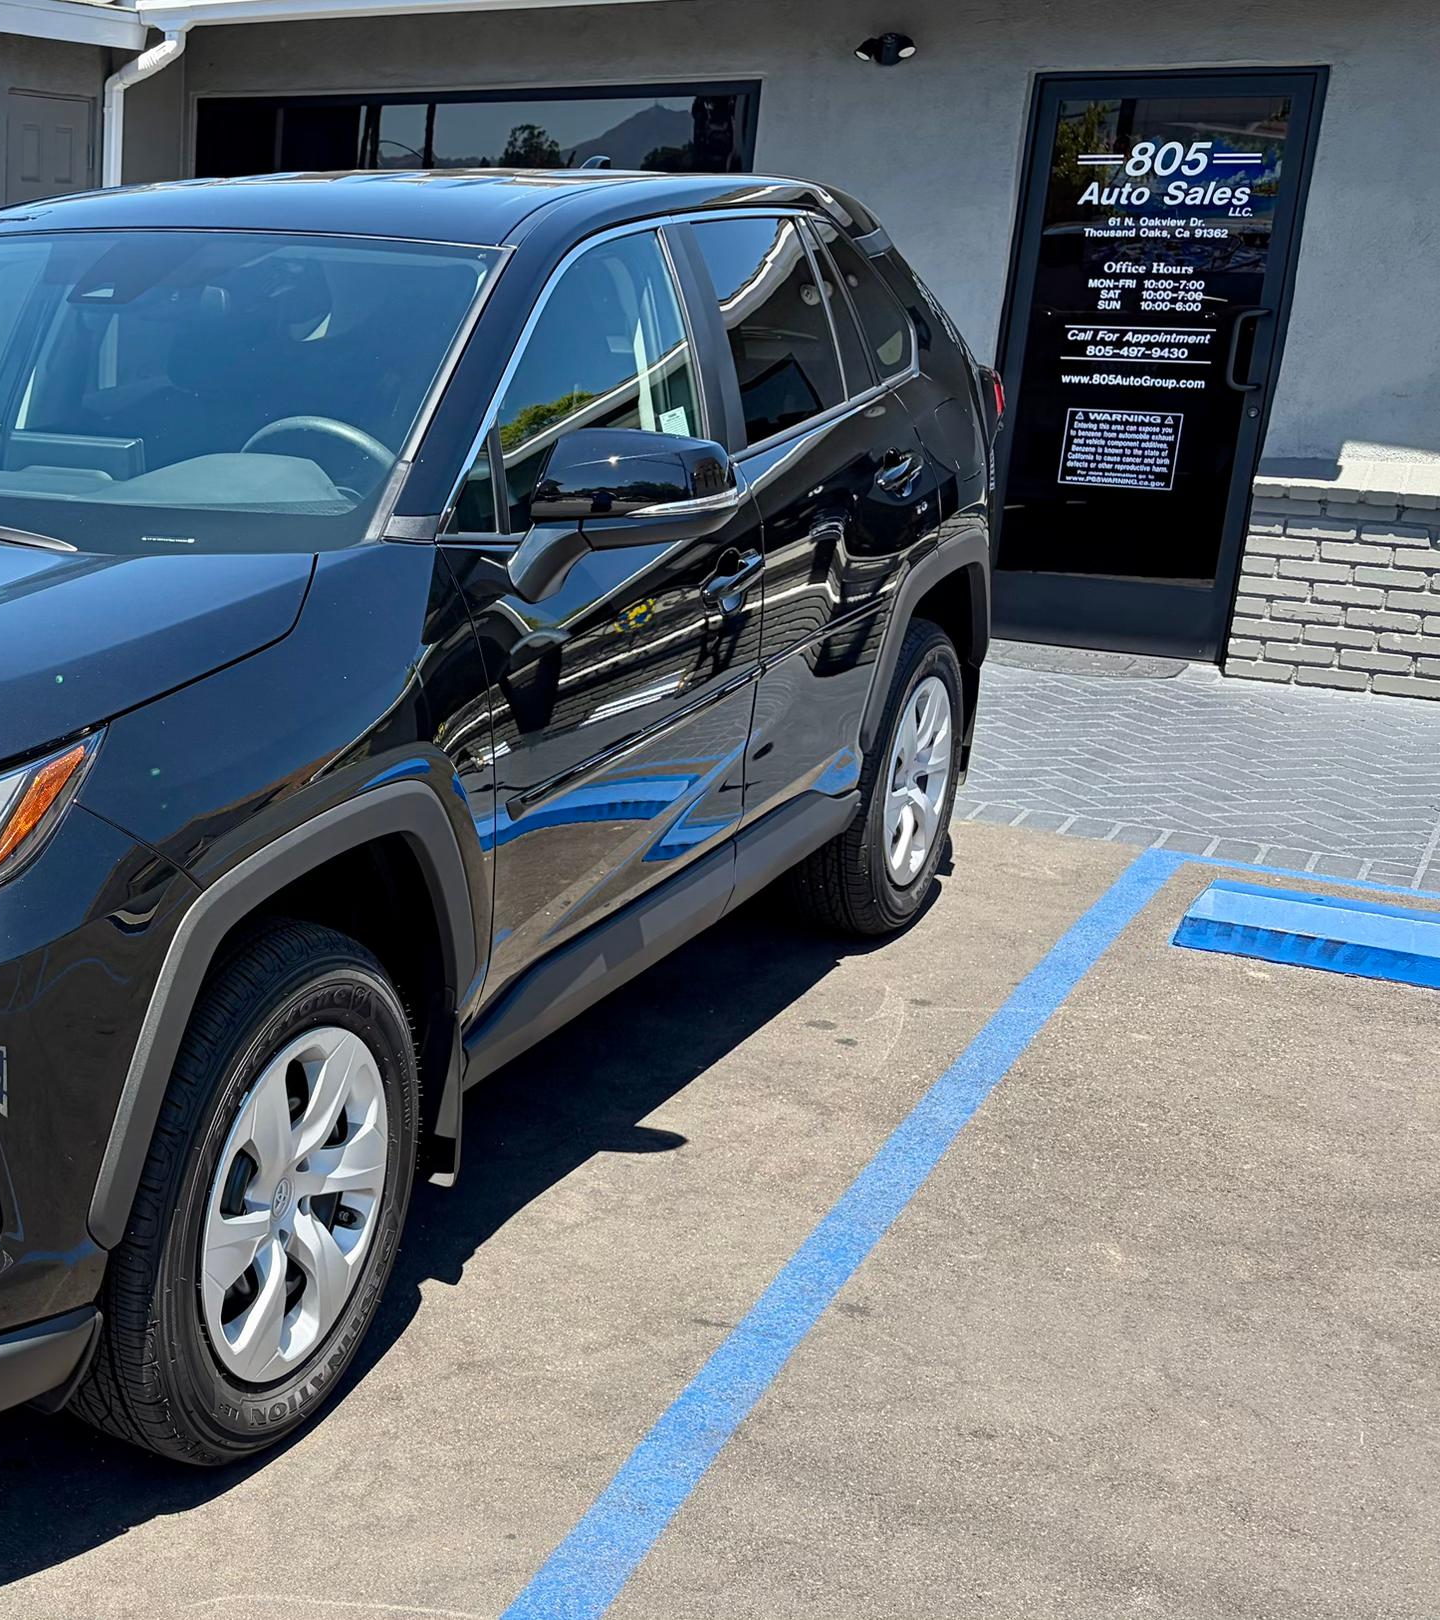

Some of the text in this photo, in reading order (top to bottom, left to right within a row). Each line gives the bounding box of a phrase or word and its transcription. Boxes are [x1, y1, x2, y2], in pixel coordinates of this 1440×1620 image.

[1125, 141, 1212, 177] 805
[1077, 181, 1251, 206] Auto Sales
[1228, 207, 1253, 217] LLC.
[1108, 217, 1205, 227] 61 N. Oakview Dr.
[1084, 228, 1228, 239] Thousand Oaks, Ca 91362
[1103, 262, 1193, 275] Office Hours
[1088, 279, 1205, 290] MON-FRI 10:00-7:00
[1100, 290, 1203, 301] SAT 10:00-7:00
[1097, 300, 1201, 312] SUN 10:00-6:00
[1067, 330, 1211, 344] Call For Appointment
[1086, 345, 1188, 359] 805-497-9430
[1061, 374, 1205, 389] www.805AutoGroup.com
[1089, 412, 1161, 423] WARNING
